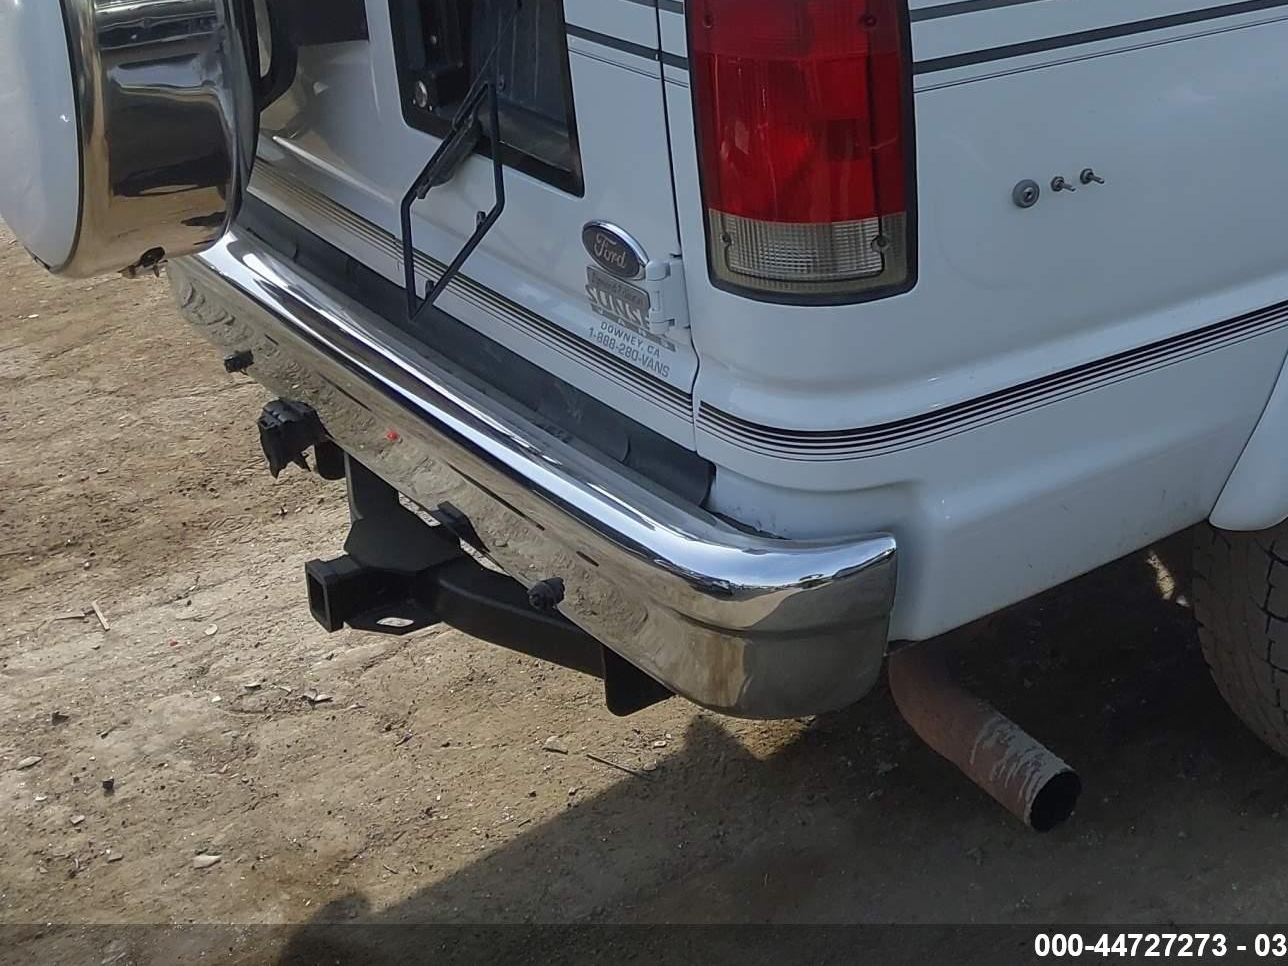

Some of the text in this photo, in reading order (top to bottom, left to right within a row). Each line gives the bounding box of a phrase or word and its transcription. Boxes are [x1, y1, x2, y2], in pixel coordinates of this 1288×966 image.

[593, 233, 626, 269] Ford
[588, 326, 671, 378] 1-888-280-VANS
[600, 321, 643, 351] DOWNEY,
[647, 345, 660, 359] CA
